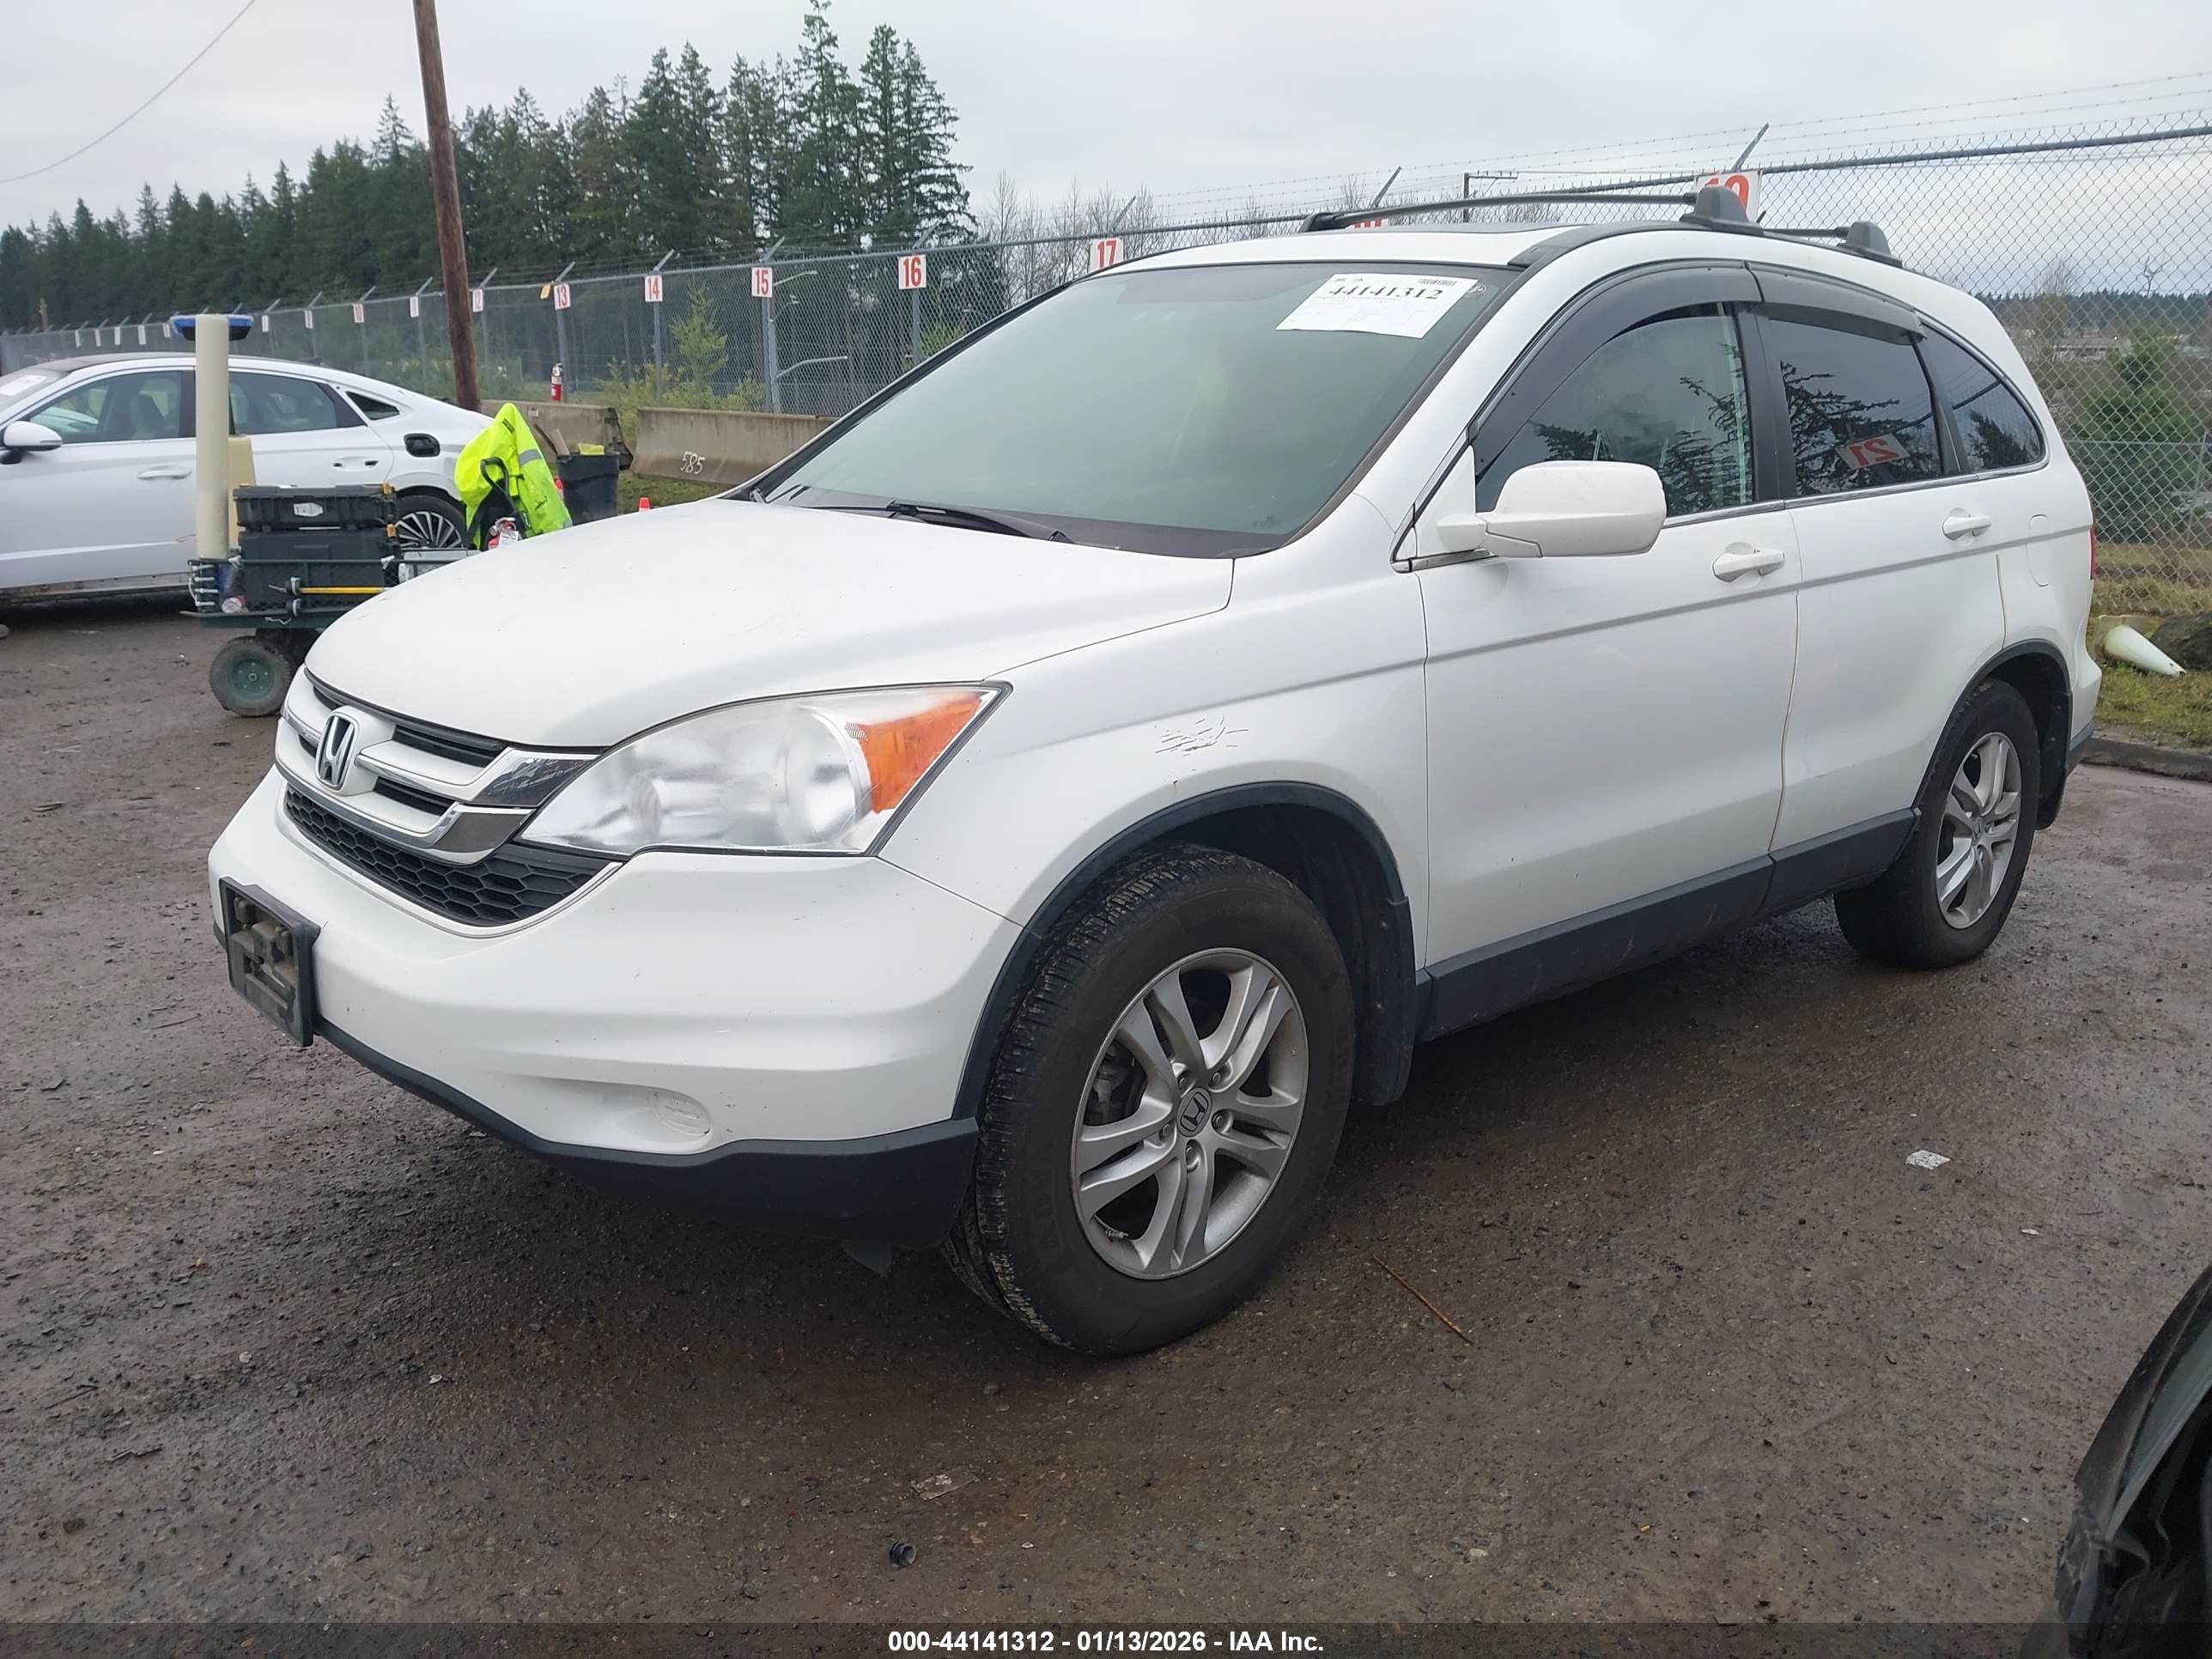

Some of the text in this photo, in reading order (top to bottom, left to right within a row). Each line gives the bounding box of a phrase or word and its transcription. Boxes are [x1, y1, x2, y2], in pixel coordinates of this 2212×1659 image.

[1097, 240, 1116, 268] 17
[756, 269, 769, 295] 15
[903, 257, 921, 287] 16
[556, 285, 567, 307] 13
[648, 276, 659, 300] 14
[1328, 285, 1443, 300] 44141312
[680, 451, 705, 474] 585
